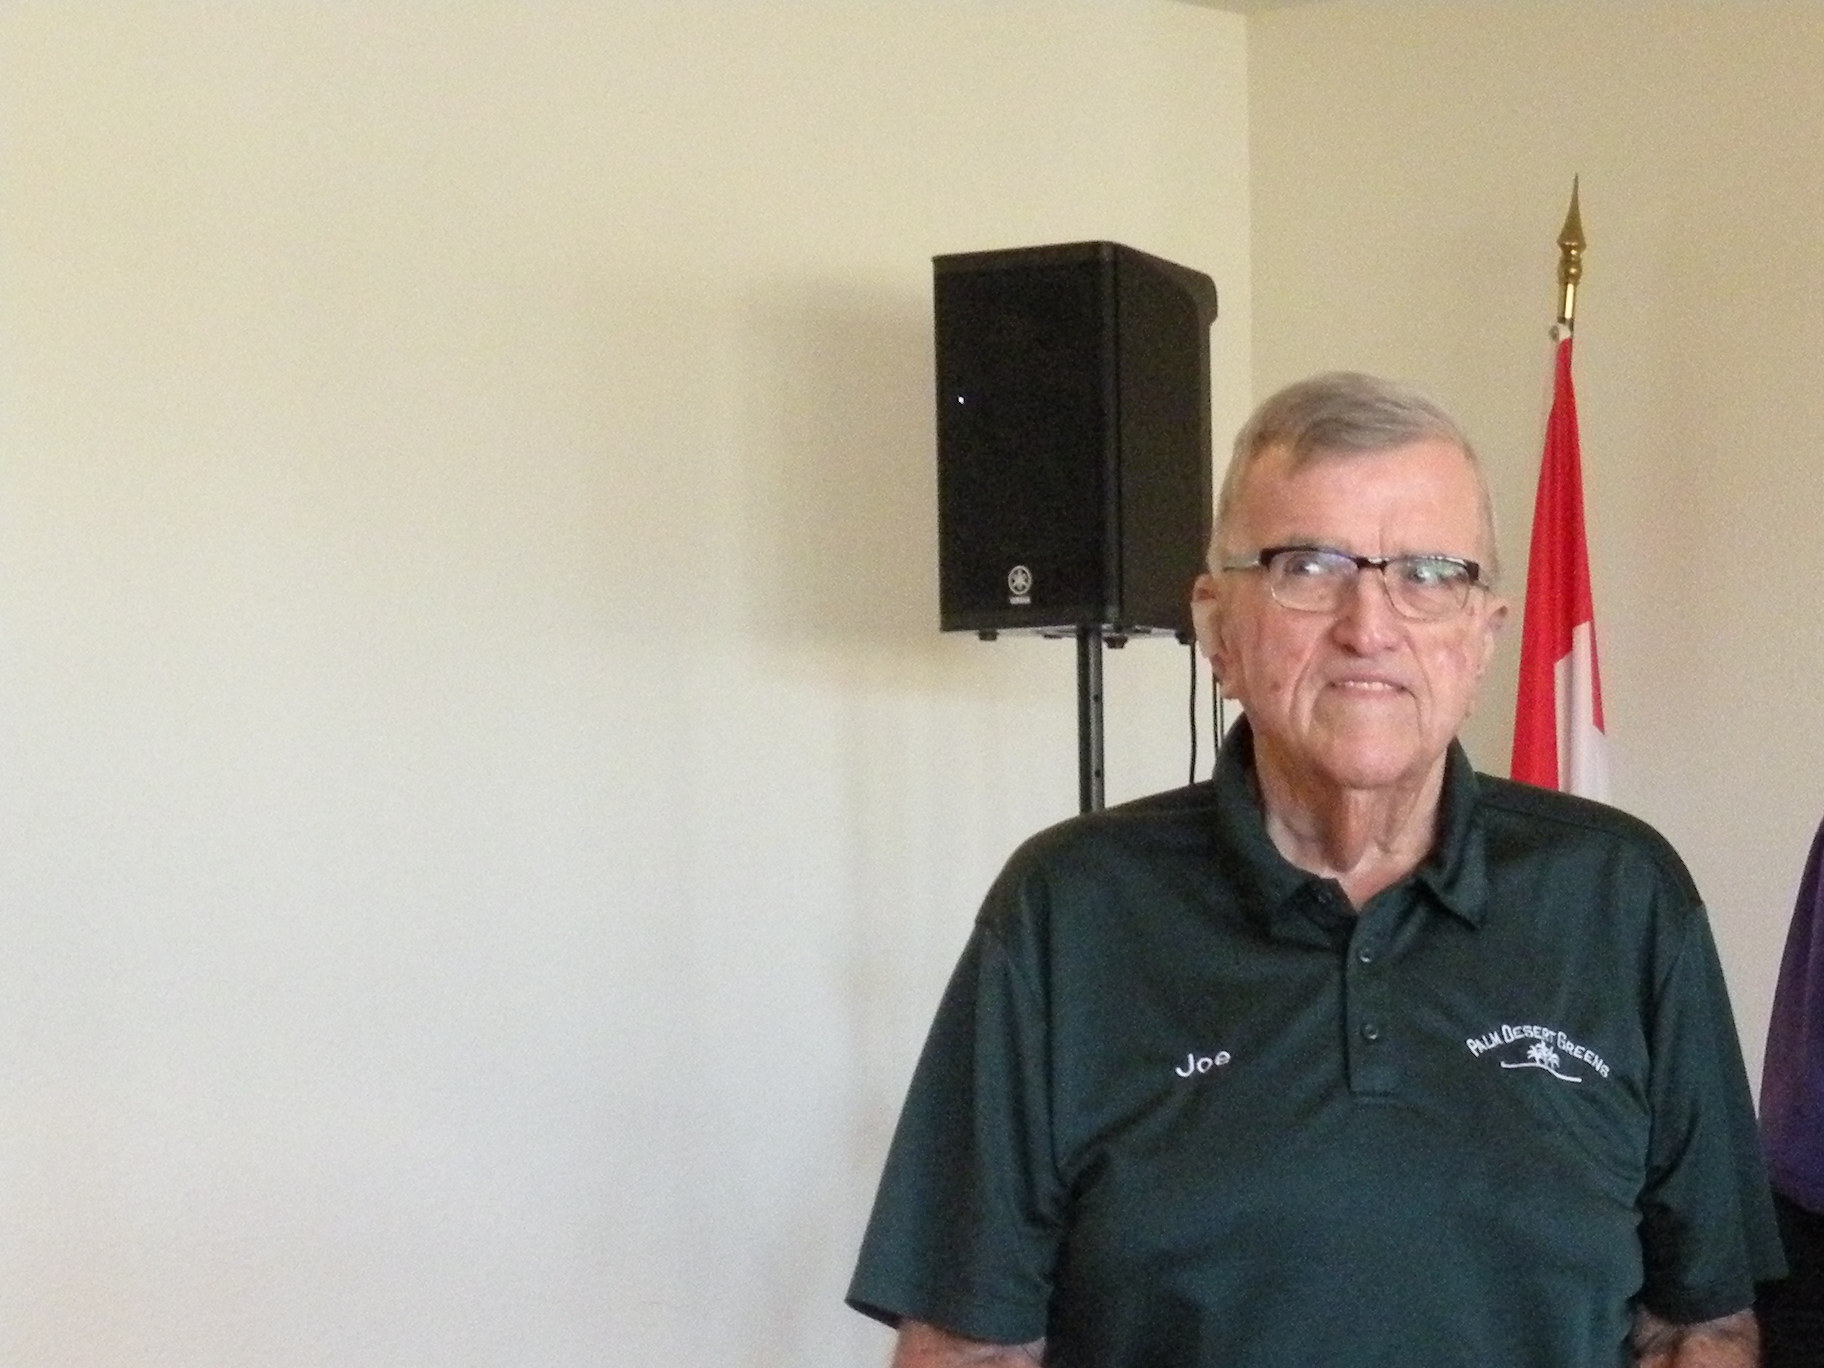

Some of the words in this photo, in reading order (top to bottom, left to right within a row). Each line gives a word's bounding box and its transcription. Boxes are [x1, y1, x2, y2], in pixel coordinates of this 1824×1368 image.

[1175, 1050, 1231, 1079] Joe
[1466, 1031, 1503, 1057] PALM
[1501, 1024, 1557, 1043] DESERT
[1557, 1031, 1610, 1078] GREENS
